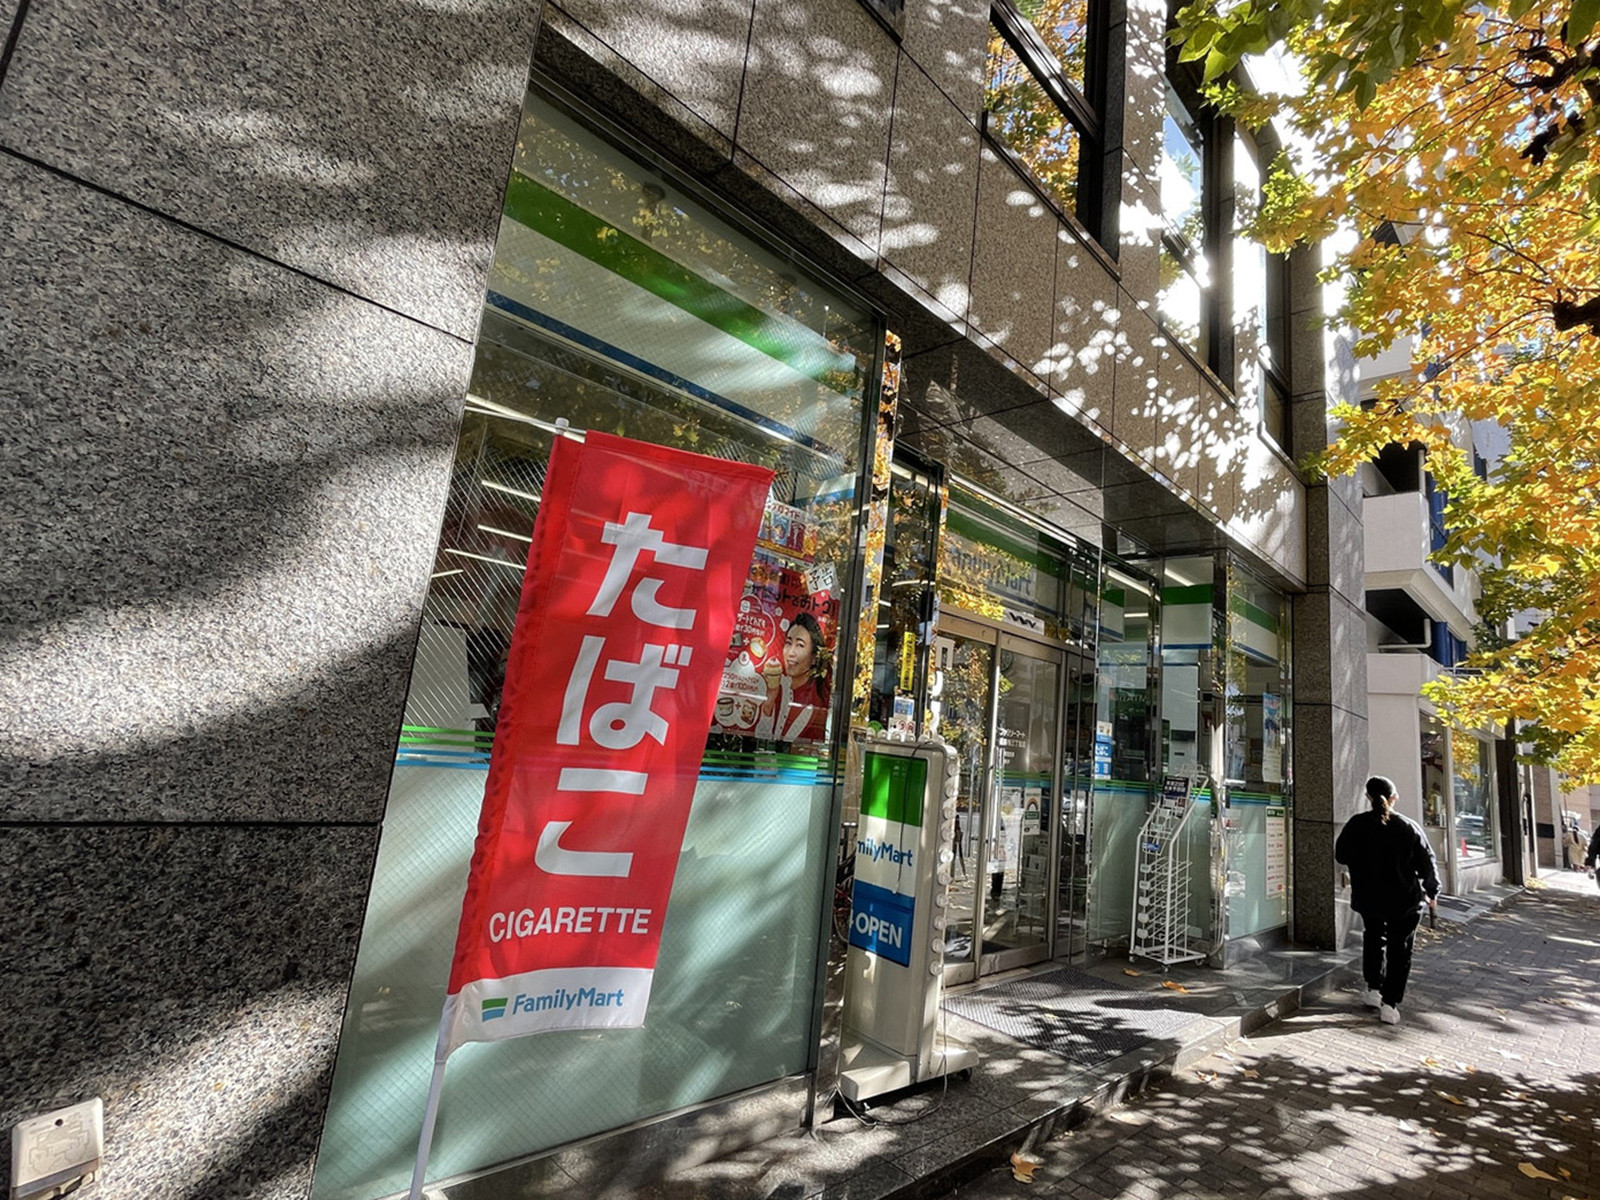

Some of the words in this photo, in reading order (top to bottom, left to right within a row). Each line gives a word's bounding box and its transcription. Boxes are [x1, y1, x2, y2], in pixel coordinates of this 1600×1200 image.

[535, 511, 708, 878] たばこ
[488, 906, 653, 945] CIGARETTE
[855, 911, 903, 949] OPEN
[512, 986, 625, 1017] FamilyMart
